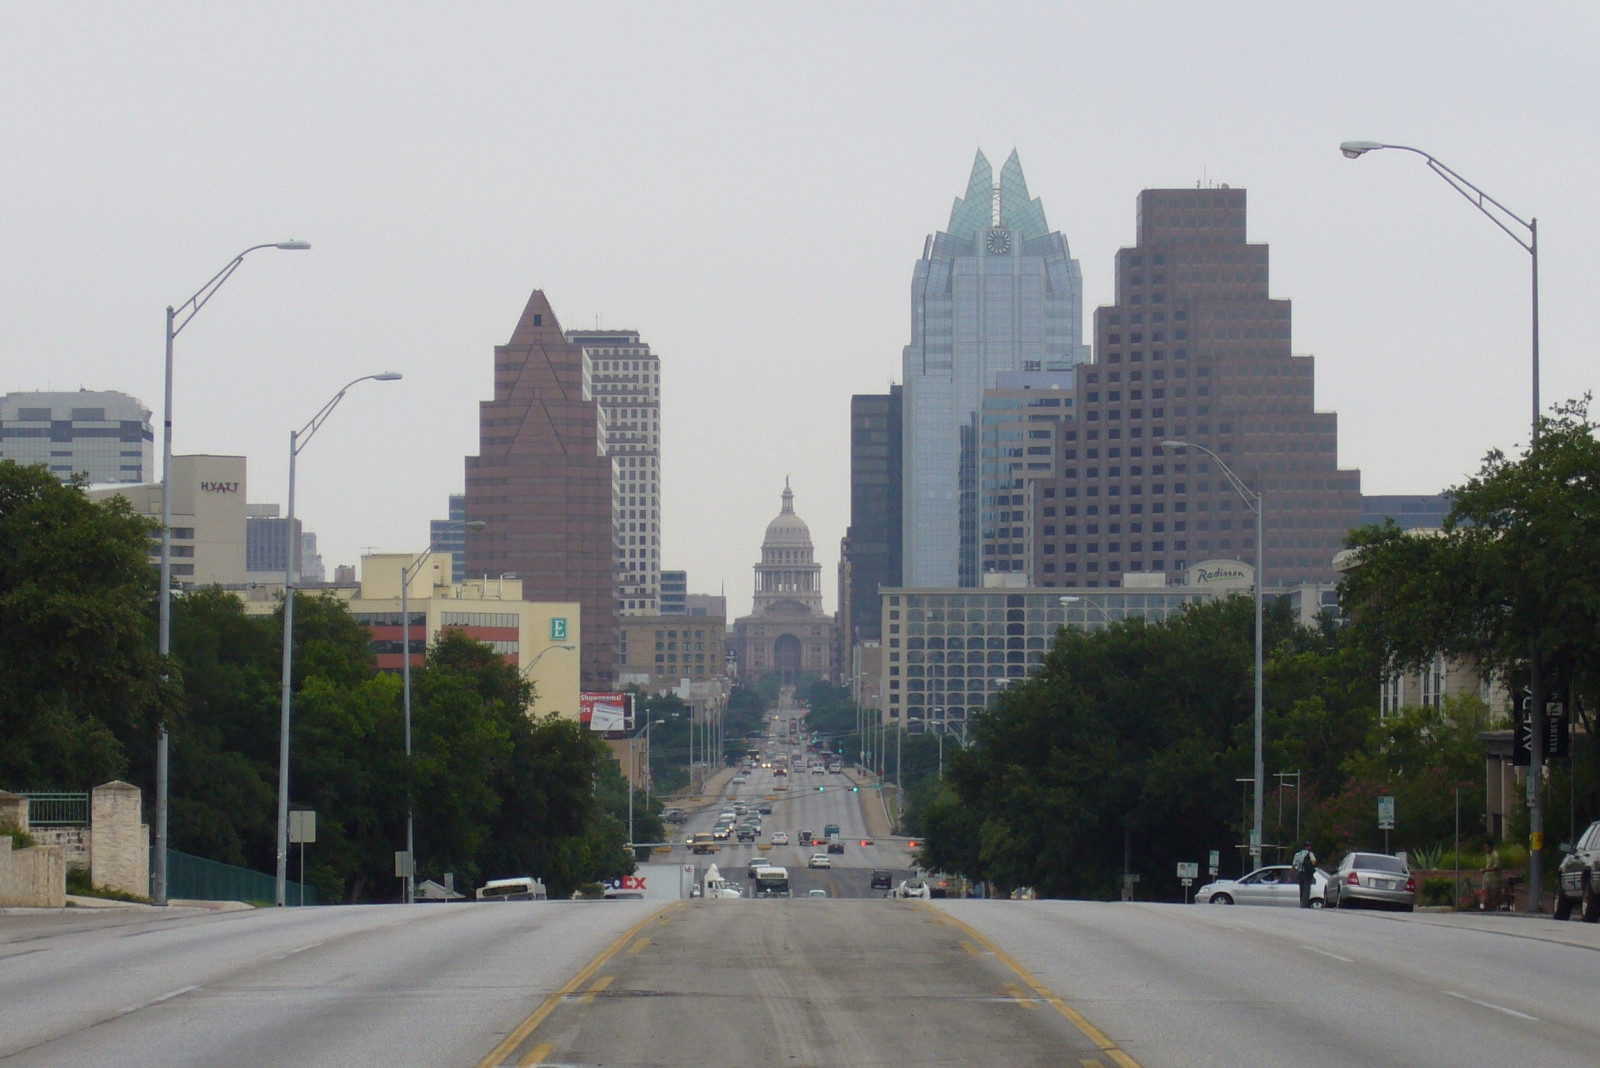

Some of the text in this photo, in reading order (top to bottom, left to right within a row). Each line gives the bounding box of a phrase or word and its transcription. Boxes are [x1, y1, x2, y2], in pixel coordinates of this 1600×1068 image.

[201, 482, 239, 493] HYATT
[1197, 567, 1245, 583] Radisson
[554, 619, 565, 637] E
[602, 874, 647, 890] edEx
